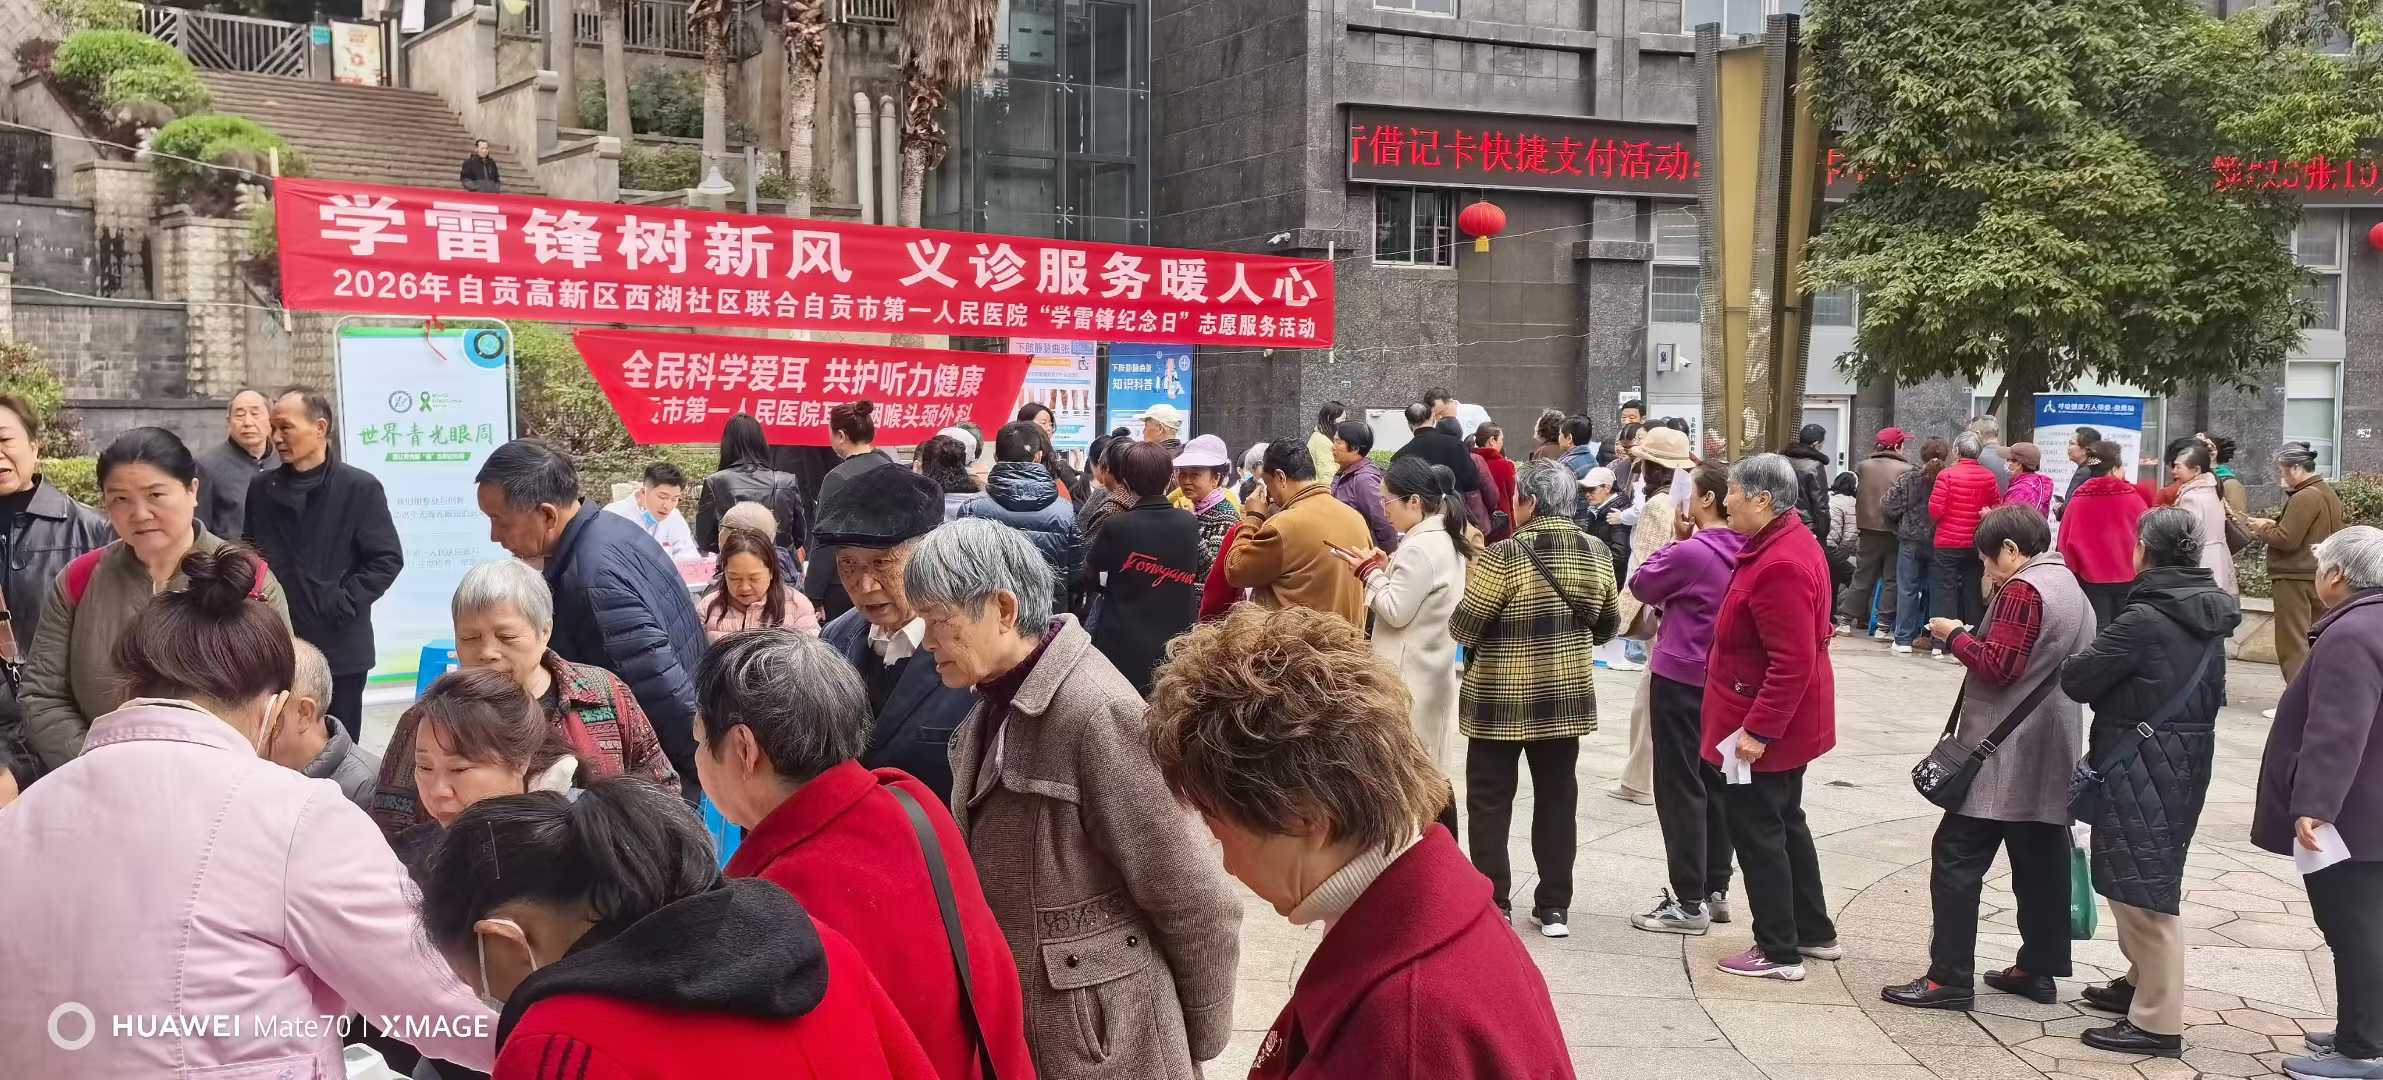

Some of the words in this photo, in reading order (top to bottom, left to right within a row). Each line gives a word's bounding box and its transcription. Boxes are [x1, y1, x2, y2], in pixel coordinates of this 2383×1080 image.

[319, 194, 853, 283] 学雷锋树新风
[899, 238, 1318, 307] 义诊服务暖人心
[622, 349, 810, 394] 全民科学爱耳
[822, 357, 985, 399] 共护听力健康
[1111, 377, 1153, 392] 知识科普
[358, 421, 494, 449] 世界青光眼周
